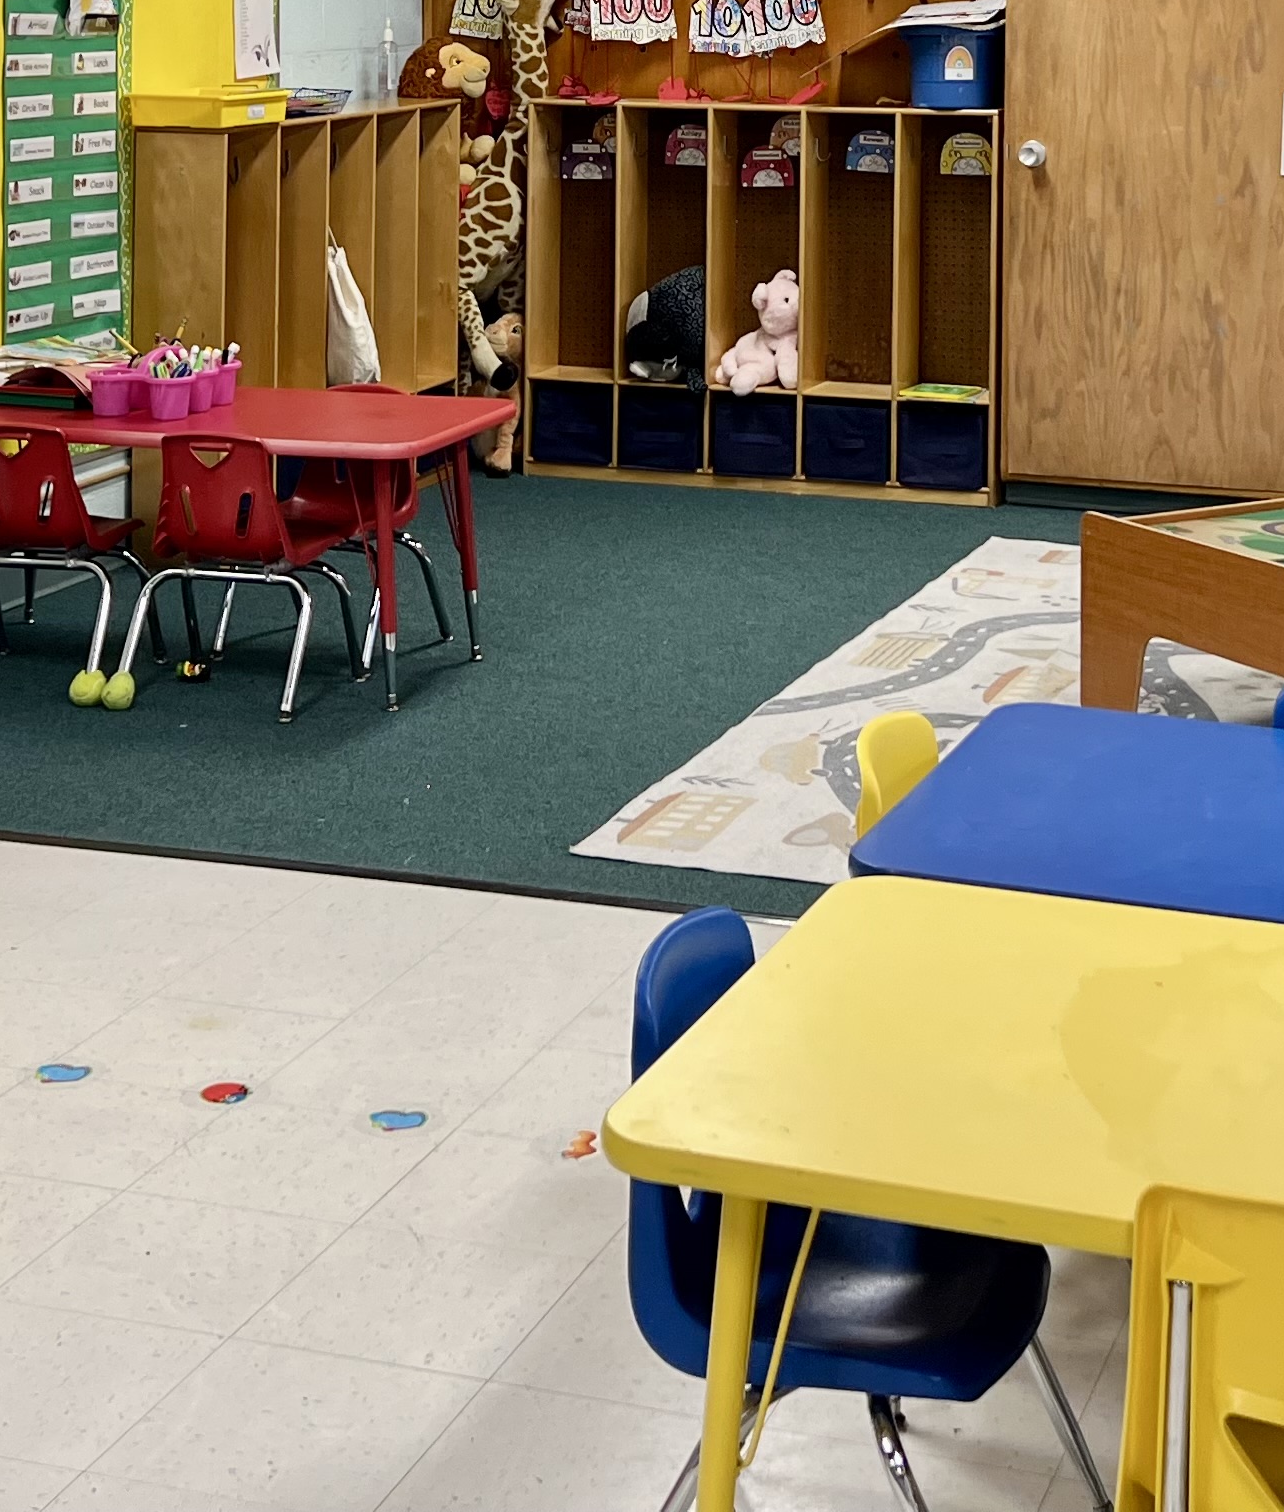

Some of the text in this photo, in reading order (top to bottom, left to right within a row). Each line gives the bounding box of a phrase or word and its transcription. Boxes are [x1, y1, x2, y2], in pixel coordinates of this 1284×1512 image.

[93, 58, 108, 68] Lunch
[38, 102, 50, 112] Time
[93, 98, 109, 109] Books
[88, 137, 113, 149] Free Play
[90, 178, 114, 190] Clean Up
[24, 311, 49, 324] Clean Up
